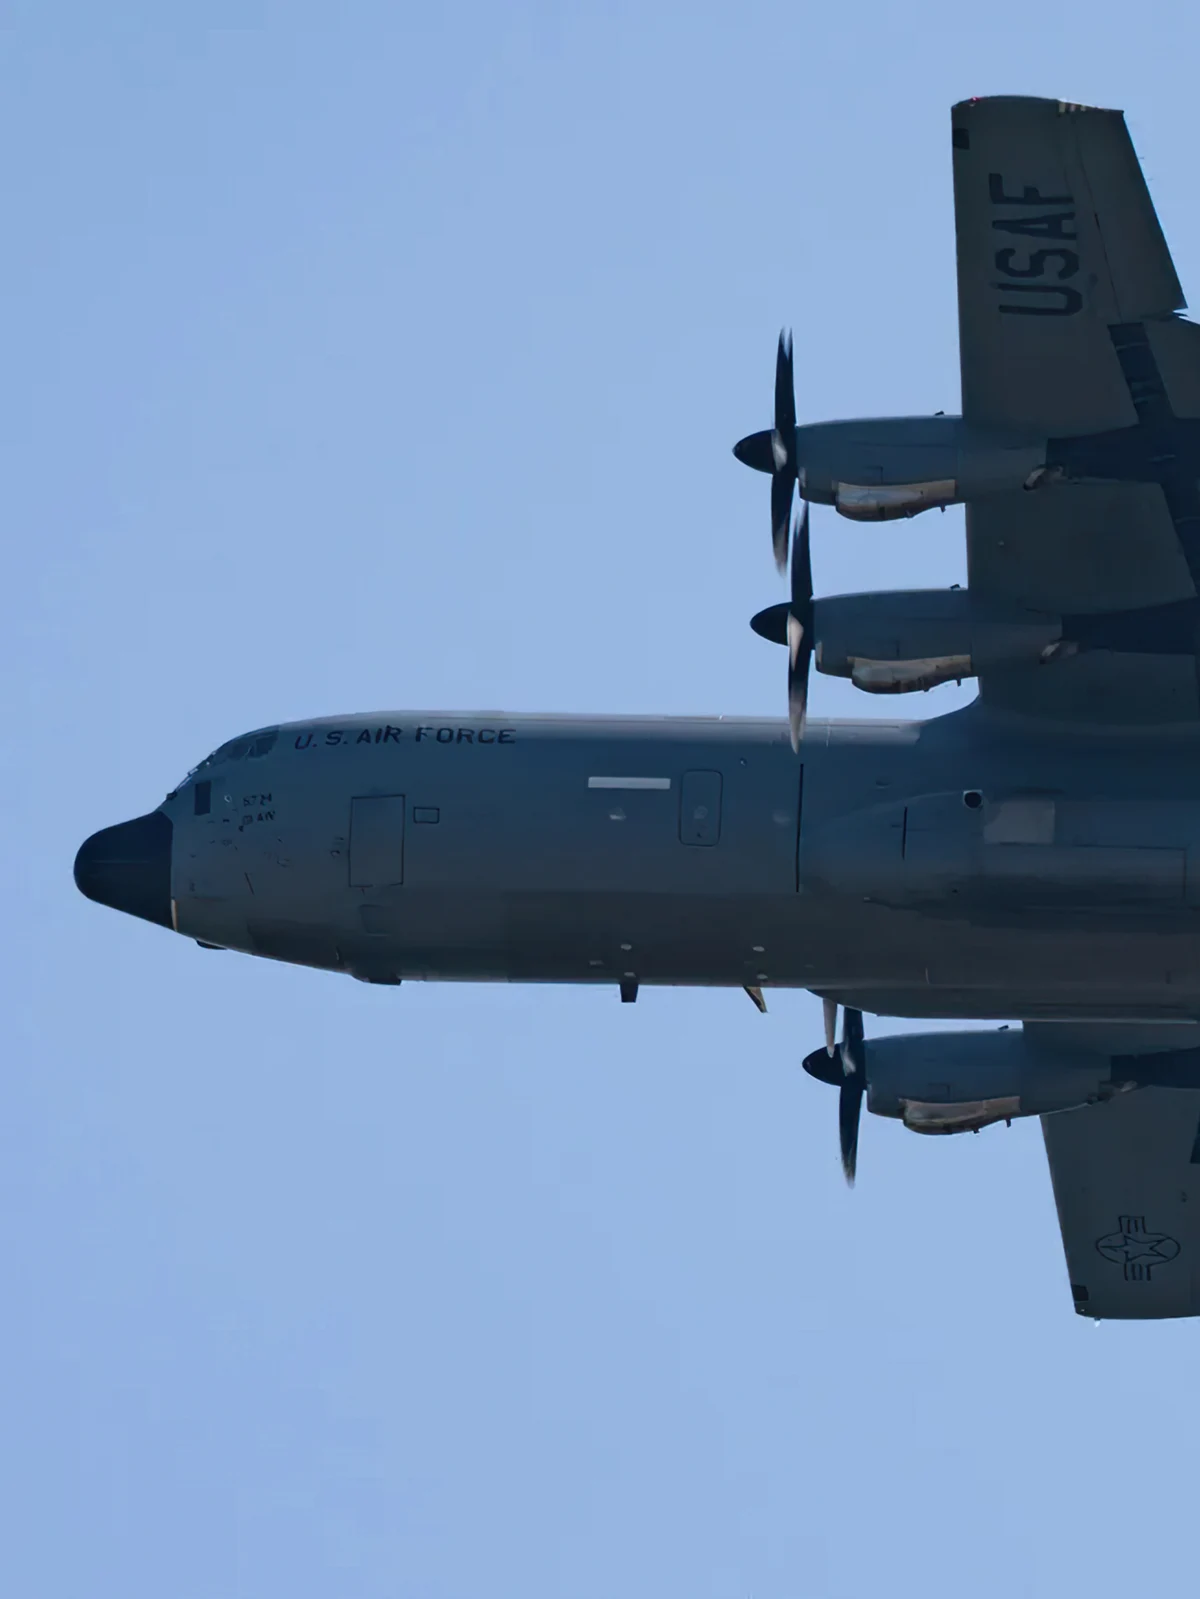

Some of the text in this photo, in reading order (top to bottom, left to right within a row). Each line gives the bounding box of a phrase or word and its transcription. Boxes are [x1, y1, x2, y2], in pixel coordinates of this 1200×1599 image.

[988, 172, 1083, 316] USAF
[356, 725, 403, 745] AIR
[414, 727, 517, 745] FORCE
